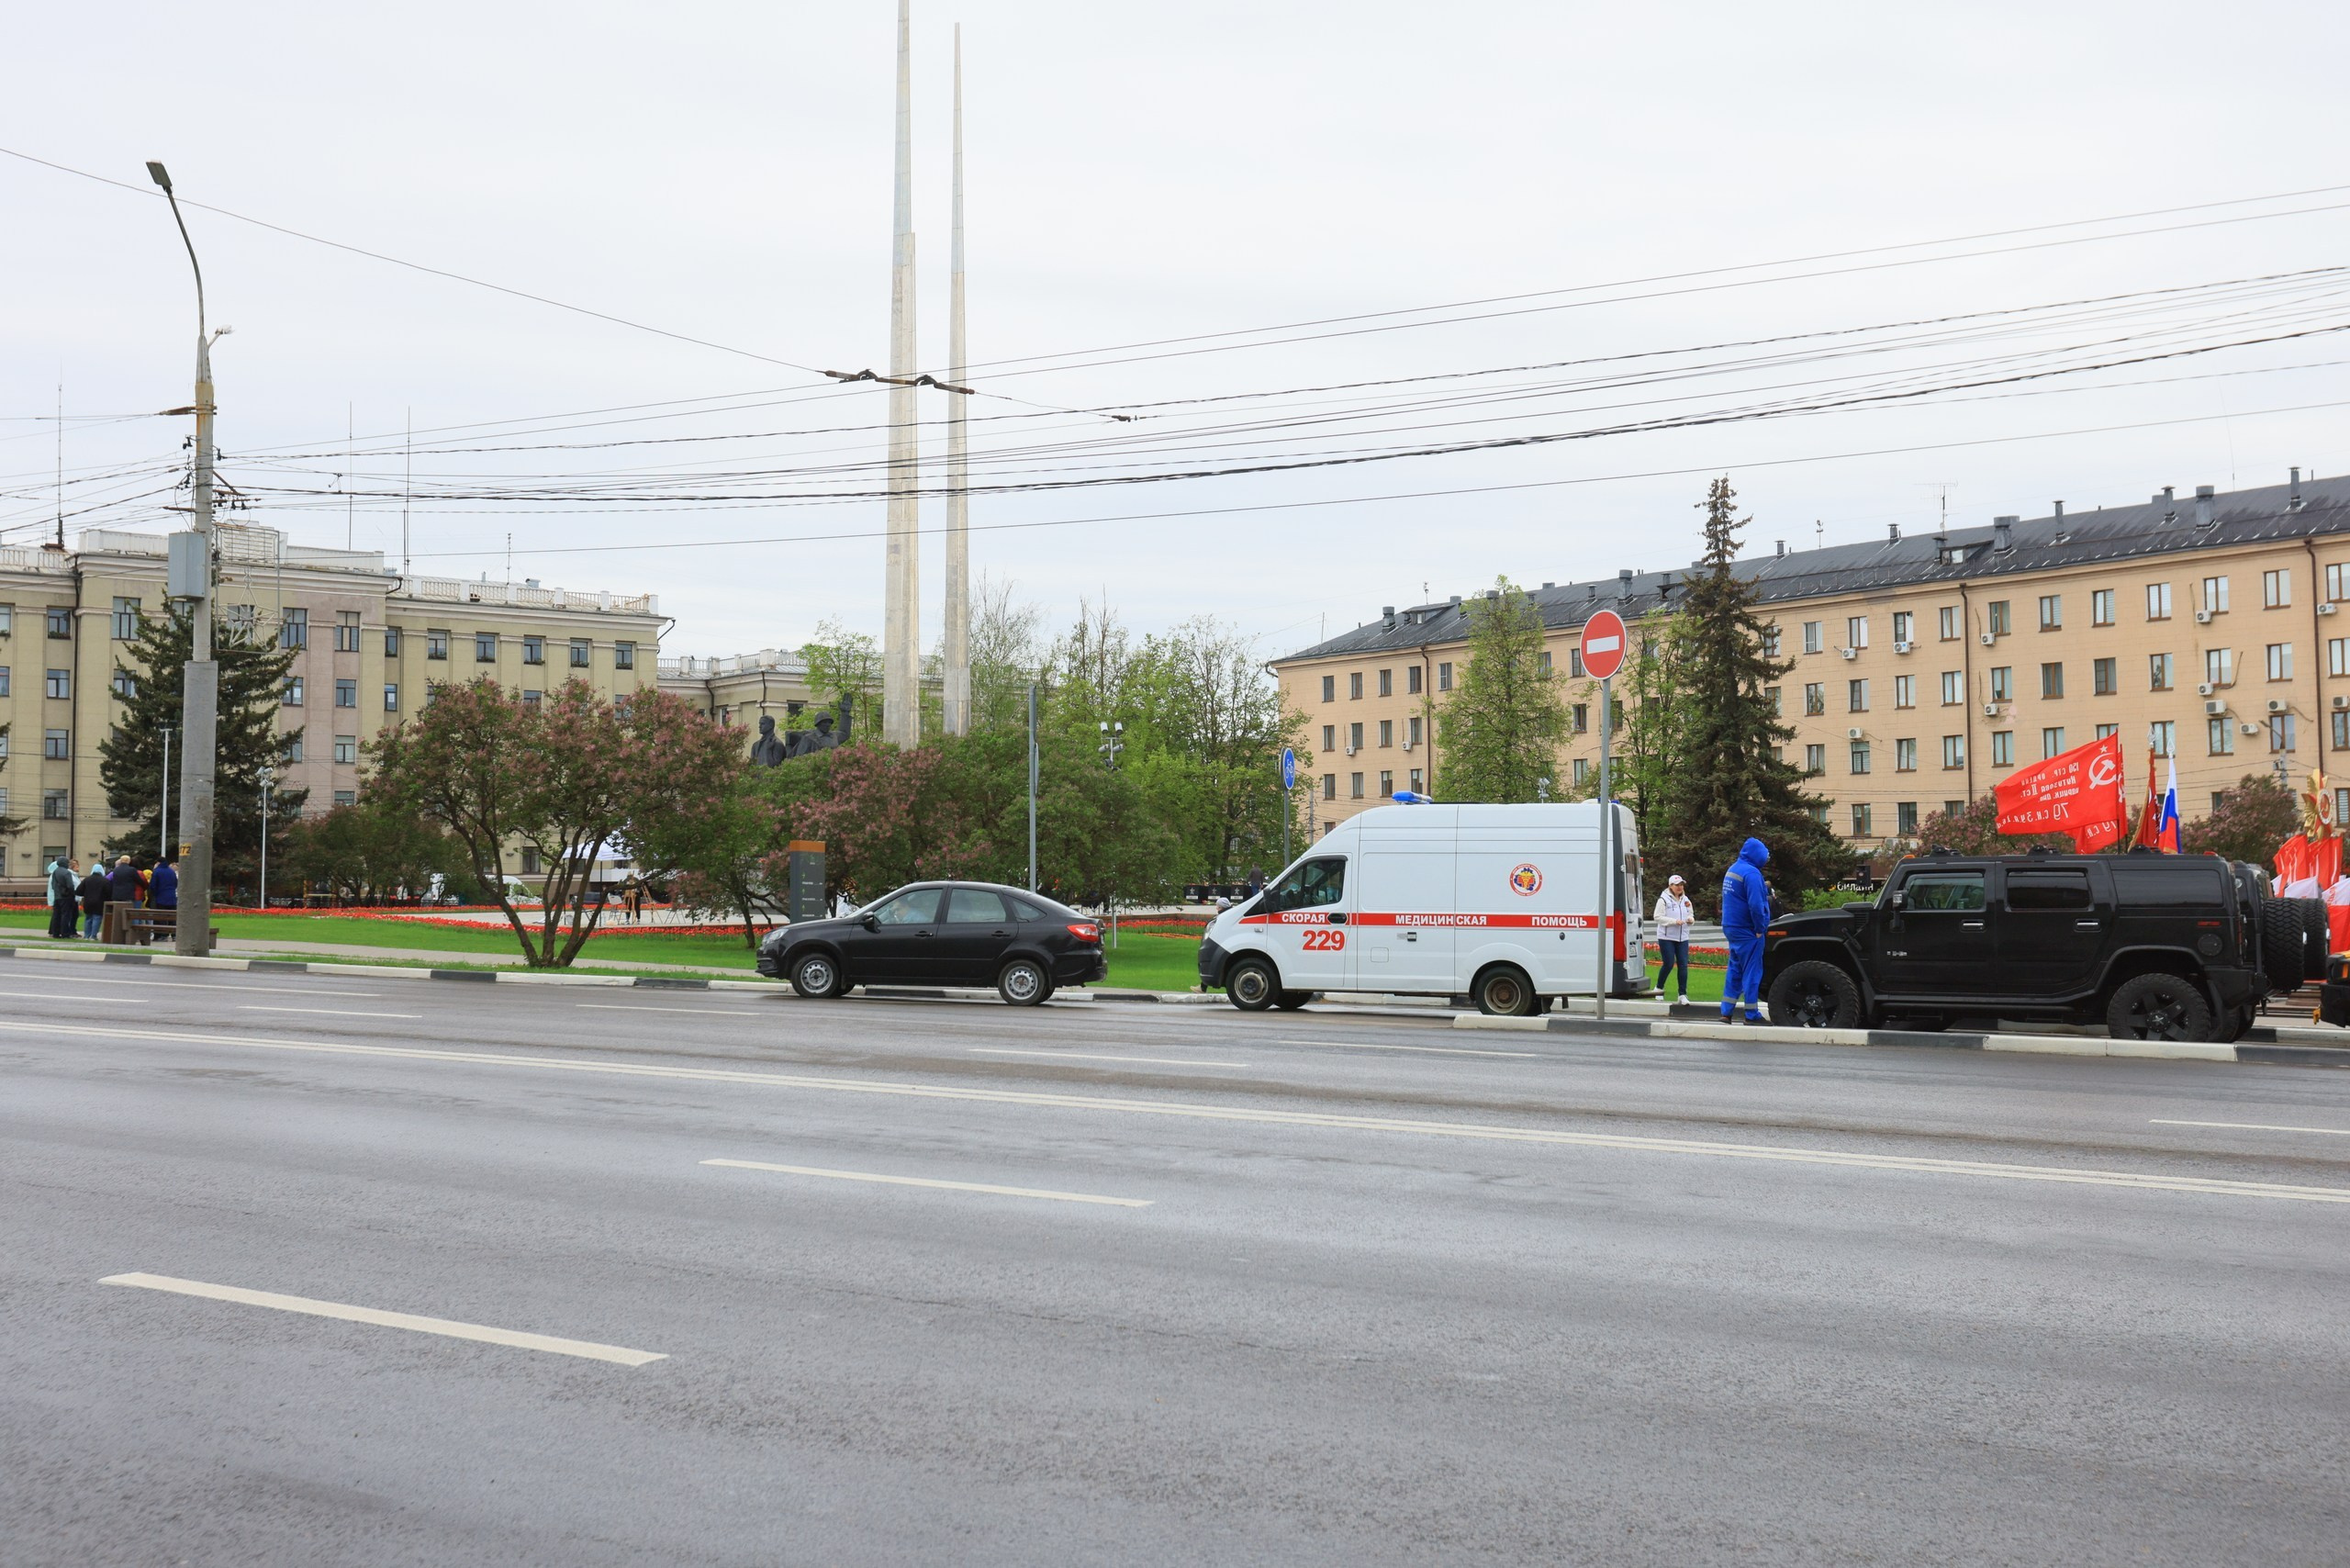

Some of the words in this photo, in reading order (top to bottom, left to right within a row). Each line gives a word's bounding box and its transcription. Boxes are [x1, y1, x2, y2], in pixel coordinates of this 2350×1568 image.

[1281, 913, 1326, 924] СКОРАЯ
[1395, 914, 1487, 927] МЕДИЦИНСКАЯ
[1531, 916, 1588, 928] ПОМОЩЬ
[1302, 930, 1346, 951] 229
